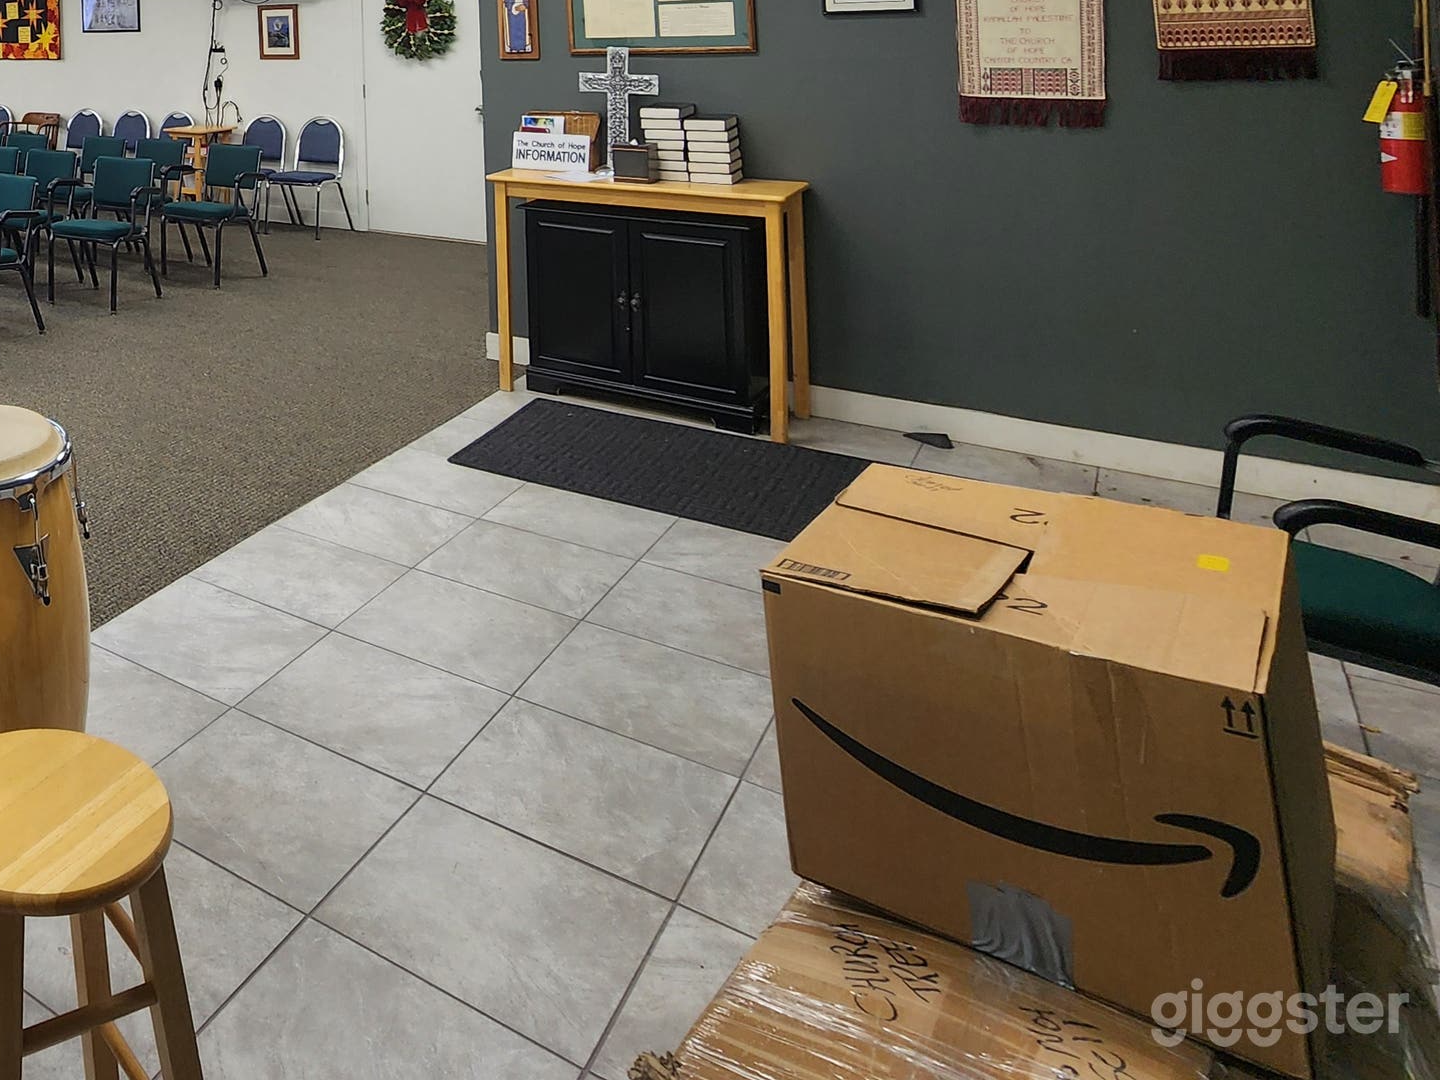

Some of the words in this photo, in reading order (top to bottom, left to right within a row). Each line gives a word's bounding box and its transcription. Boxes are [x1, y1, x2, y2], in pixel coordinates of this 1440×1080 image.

[532, 140, 555, 149] Church
[568, 142, 586, 150] Hope
[516, 149, 586, 163] INFORMATION
[829, 923, 898, 1021] CHURCH
